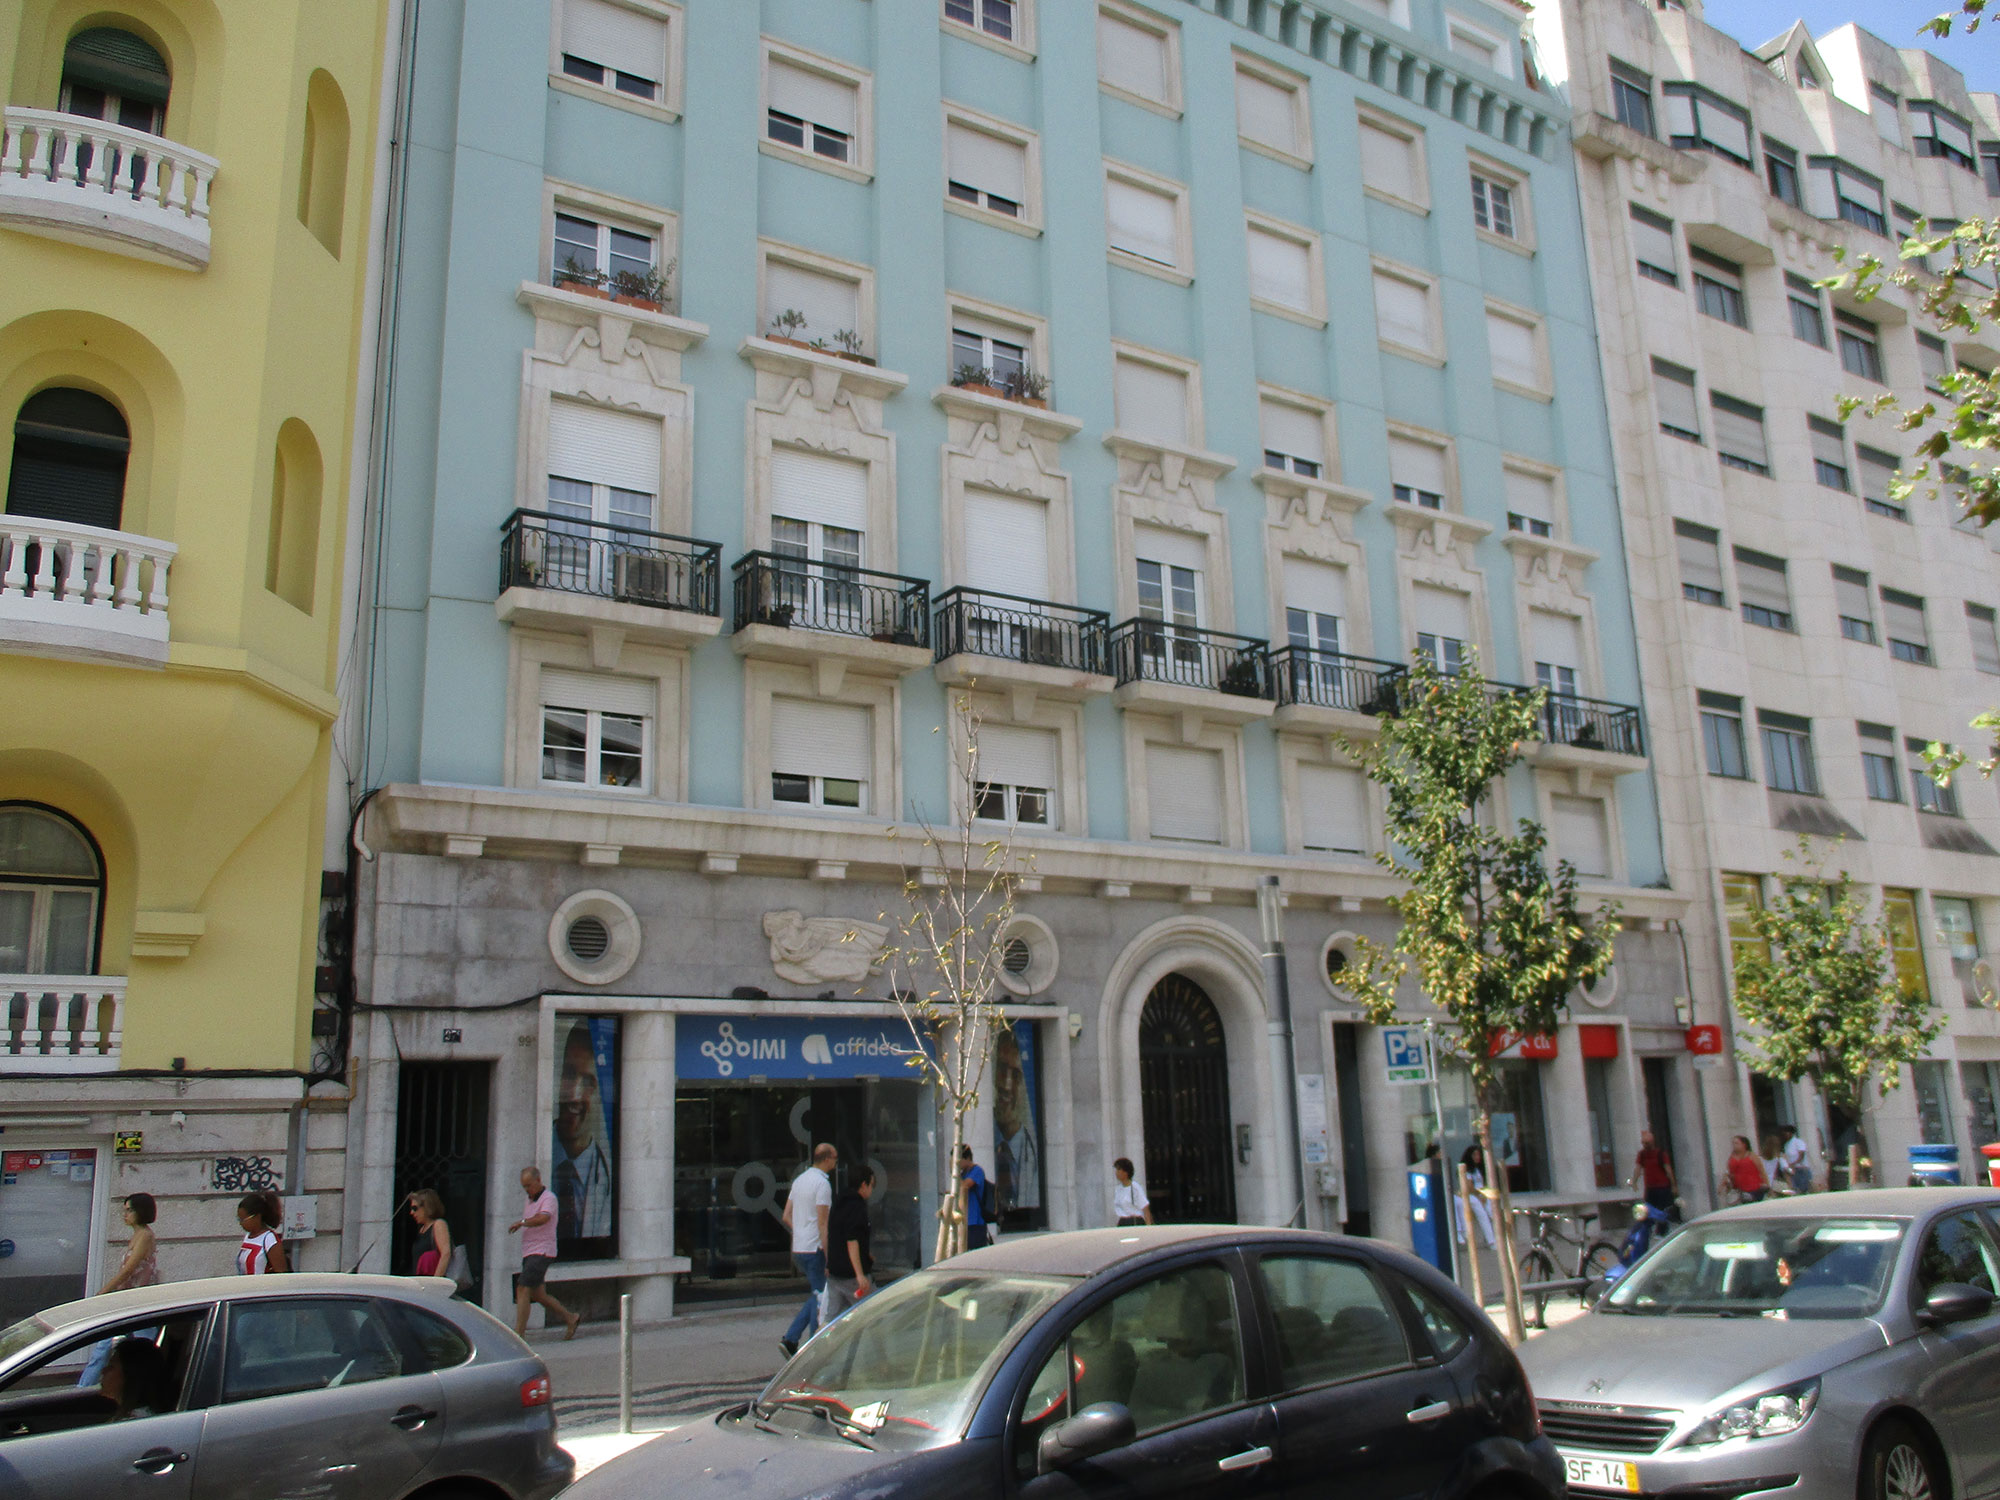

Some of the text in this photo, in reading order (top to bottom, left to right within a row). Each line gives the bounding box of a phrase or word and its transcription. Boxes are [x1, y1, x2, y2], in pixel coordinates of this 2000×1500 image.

[752, 1036, 901, 1060] IMI affidea
[1388, 1033, 1407, 1065] P
[1415, 1175, 1427, 1196] P
